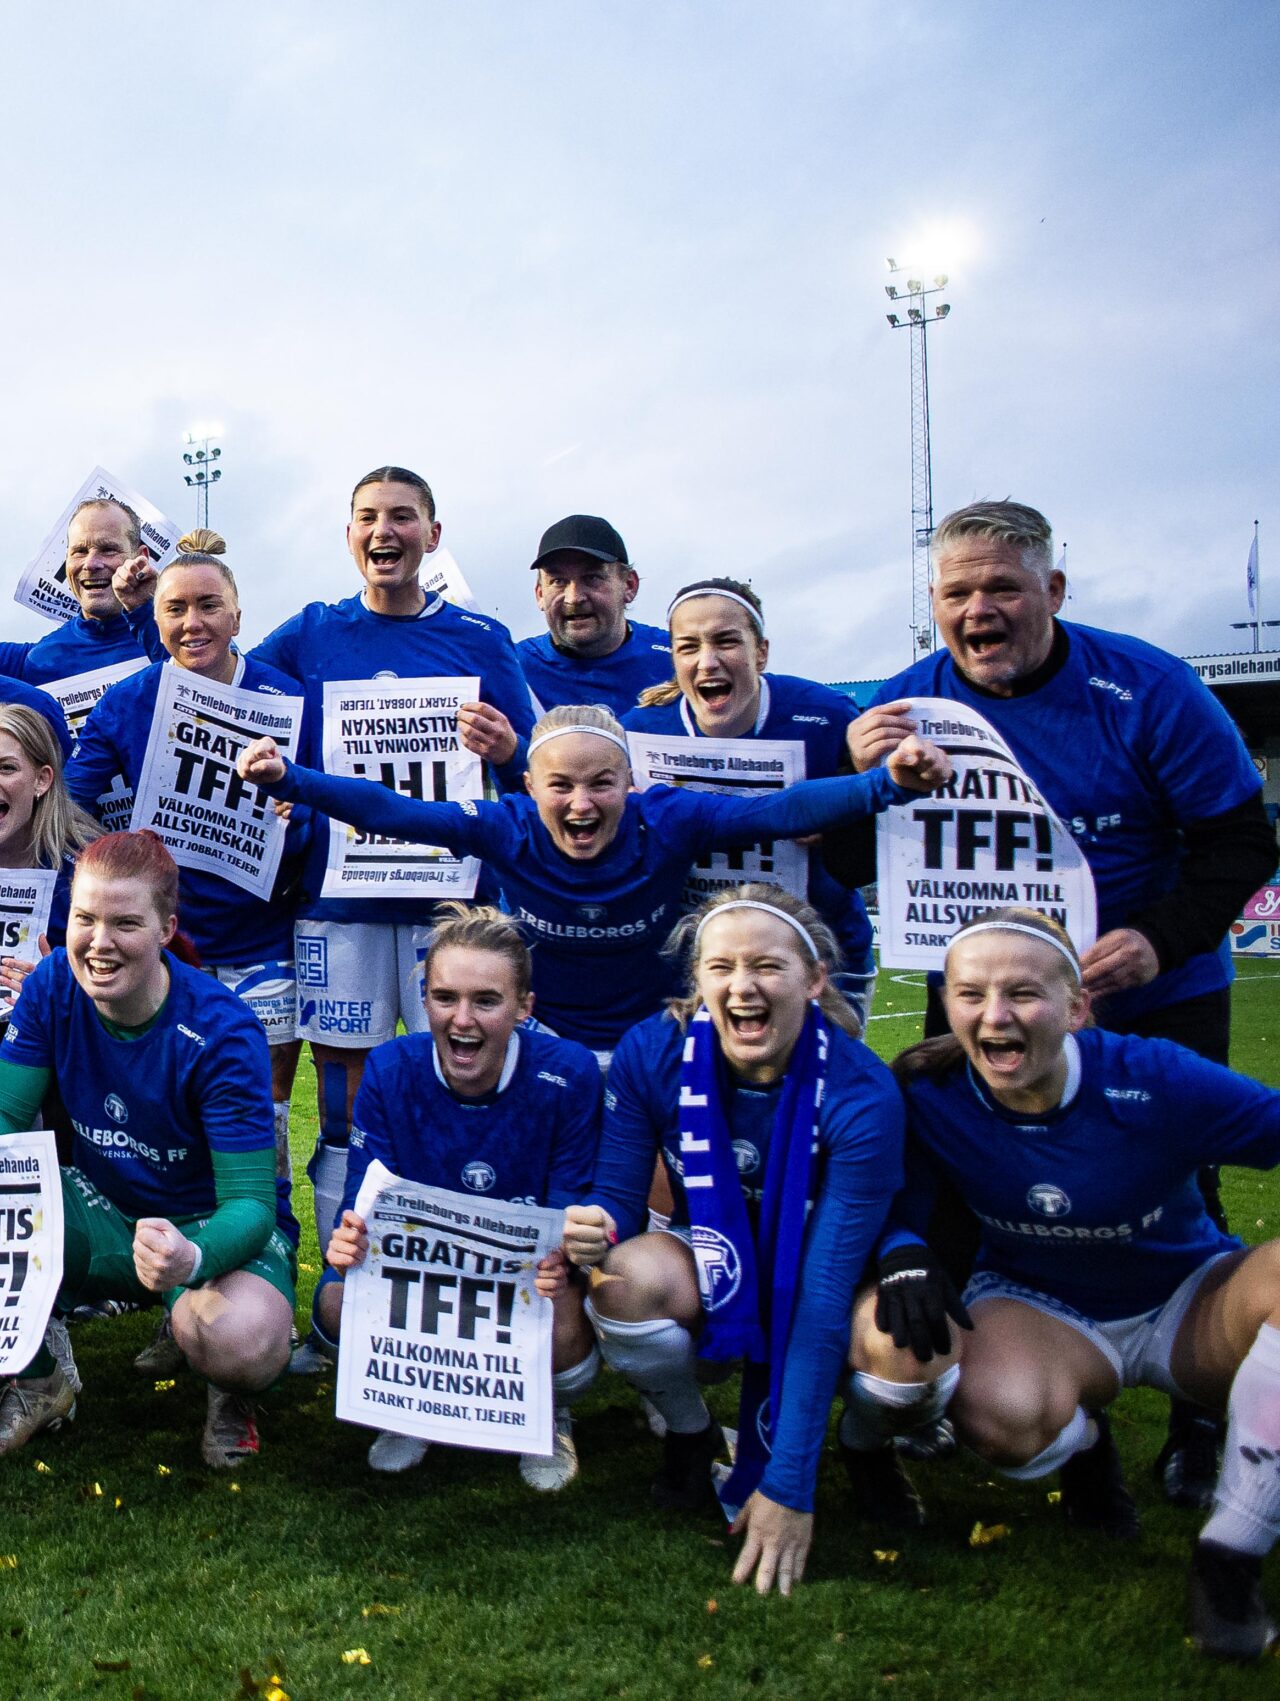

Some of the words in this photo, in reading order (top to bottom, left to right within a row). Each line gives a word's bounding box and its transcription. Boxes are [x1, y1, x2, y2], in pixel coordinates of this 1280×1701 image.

[141, 522, 171, 551] Allehanda
[32, 588, 82, 613] ALLSVE
[38, 578, 78, 604] VÄLKO
[29, 598, 58, 614] STARKT
[651, 644, 672, 653] CRA
[1194, 658, 1280, 678] orgsallehand
[259, 684, 281, 695] CRAFT
[1089, 677, 1123, 694] CRAFT
[57, 688, 102, 707] Trelleborgs
[340, 700, 376, 711] TJEJER!
[419, 697, 458, 708] STARKT
[191, 690, 247, 720] Trelleborgs
[248, 710, 292, 729] Allehanda
[792, 715, 821, 723] CRAFT
[341, 716, 458, 737] ALLSVENSKAN
[176, 721, 249, 762] GRAT
[343, 740, 372, 755] TILL
[376, 736, 459, 754] VÄLKOMNA
[662, 753, 725, 771] Trelleborgs
[728, 758, 783, 772] Allehanda
[932, 768, 1043, 807] RATTI
[101, 796, 133, 815] KOMN
[159, 796, 236, 831] VÄLKOMNA
[240, 821, 266, 843] TILL
[1097, 813, 1121, 832] FF
[151, 811, 265, 861] ALLSVENSKAN
[913, 808, 1053, 872] TFF!
[159, 835, 185, 849] ARKT
[185, 841, 225, 861] JOBBAT,
[227, 855, 260, 877] TJEJER!
[341, 869, 388, 882] Allehanda
[389, 870, 446, 883] Trelleborgs
[907, 879, 1019, 902] VÄLKOMNA
[1023, 883, 1064, 902] TILL
[520, 907, 646, 938] TRELLEBORGS
[651, 904, 665, 922] FF
[244, 999, 281, 1008] elleborgs
[320, 1000, 372, 1017] INTER
[261, 1016, 290, 1026] RAFT
[319, 1017, 371, 1033] SPORT
[177, 1024, 201, 1044] CRAFT
[1105, 1088, 1141, 1100] CRAFT
[71, 1118, 160, 1161] ELLEBORGS
[167, 1148, 188, 1162] FF
[396, 1194, 470, 1225] Trelleborgs
[473, 1215, 539, 1240] Allehanda
[983, 1215, 1132, 1238] ELLEBORGS
[1142, 1206, 1163, 1228] FF
[381, 1233, 522, 1275] GRATTIS
[381, 1266, 517, 1345] TFF!
[370, 1335, 478, 1371] VÄLKOMNA
[483, 1353, 522, 1375] TILL
[365, 1358, 525, 1402] ALLSVENSKAN
[363, 1388, 414, 1410] STARKT
[416, 1400, 472, 1421] JOBBAT,
[475, 1408, 526, 1426] TJEJER!
